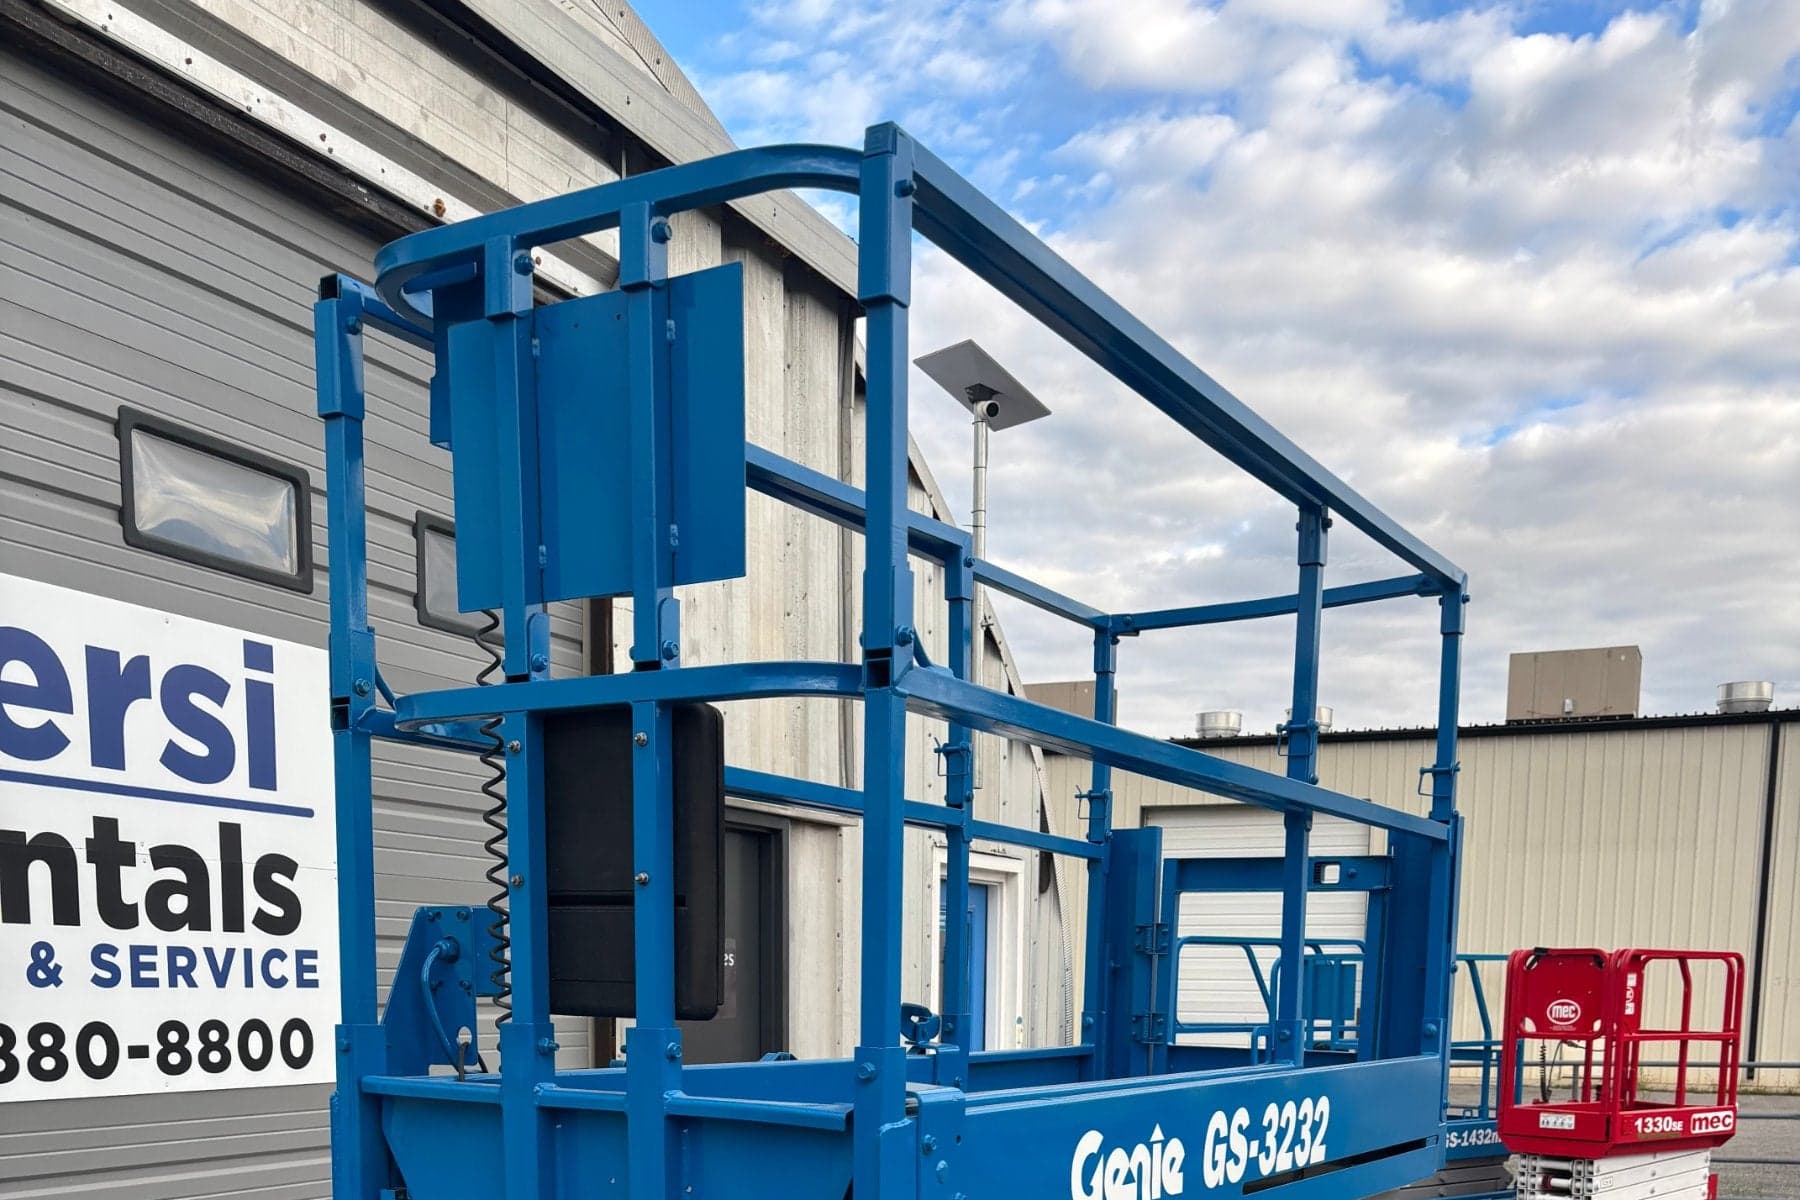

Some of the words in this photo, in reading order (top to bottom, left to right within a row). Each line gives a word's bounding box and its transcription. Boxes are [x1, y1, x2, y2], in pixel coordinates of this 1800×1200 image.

[0, 626, 278, 791] ersi
[0, 816, 302, 936] ntals
[27, 940, 63, 989] &
[90, 944, 320, 989] SERVICE
[1551, 1005, 1577, 1019] mec
[1203, 1095, 1330, 1189] GS-3232
[1692, 1114, 1732, 1132] mec
